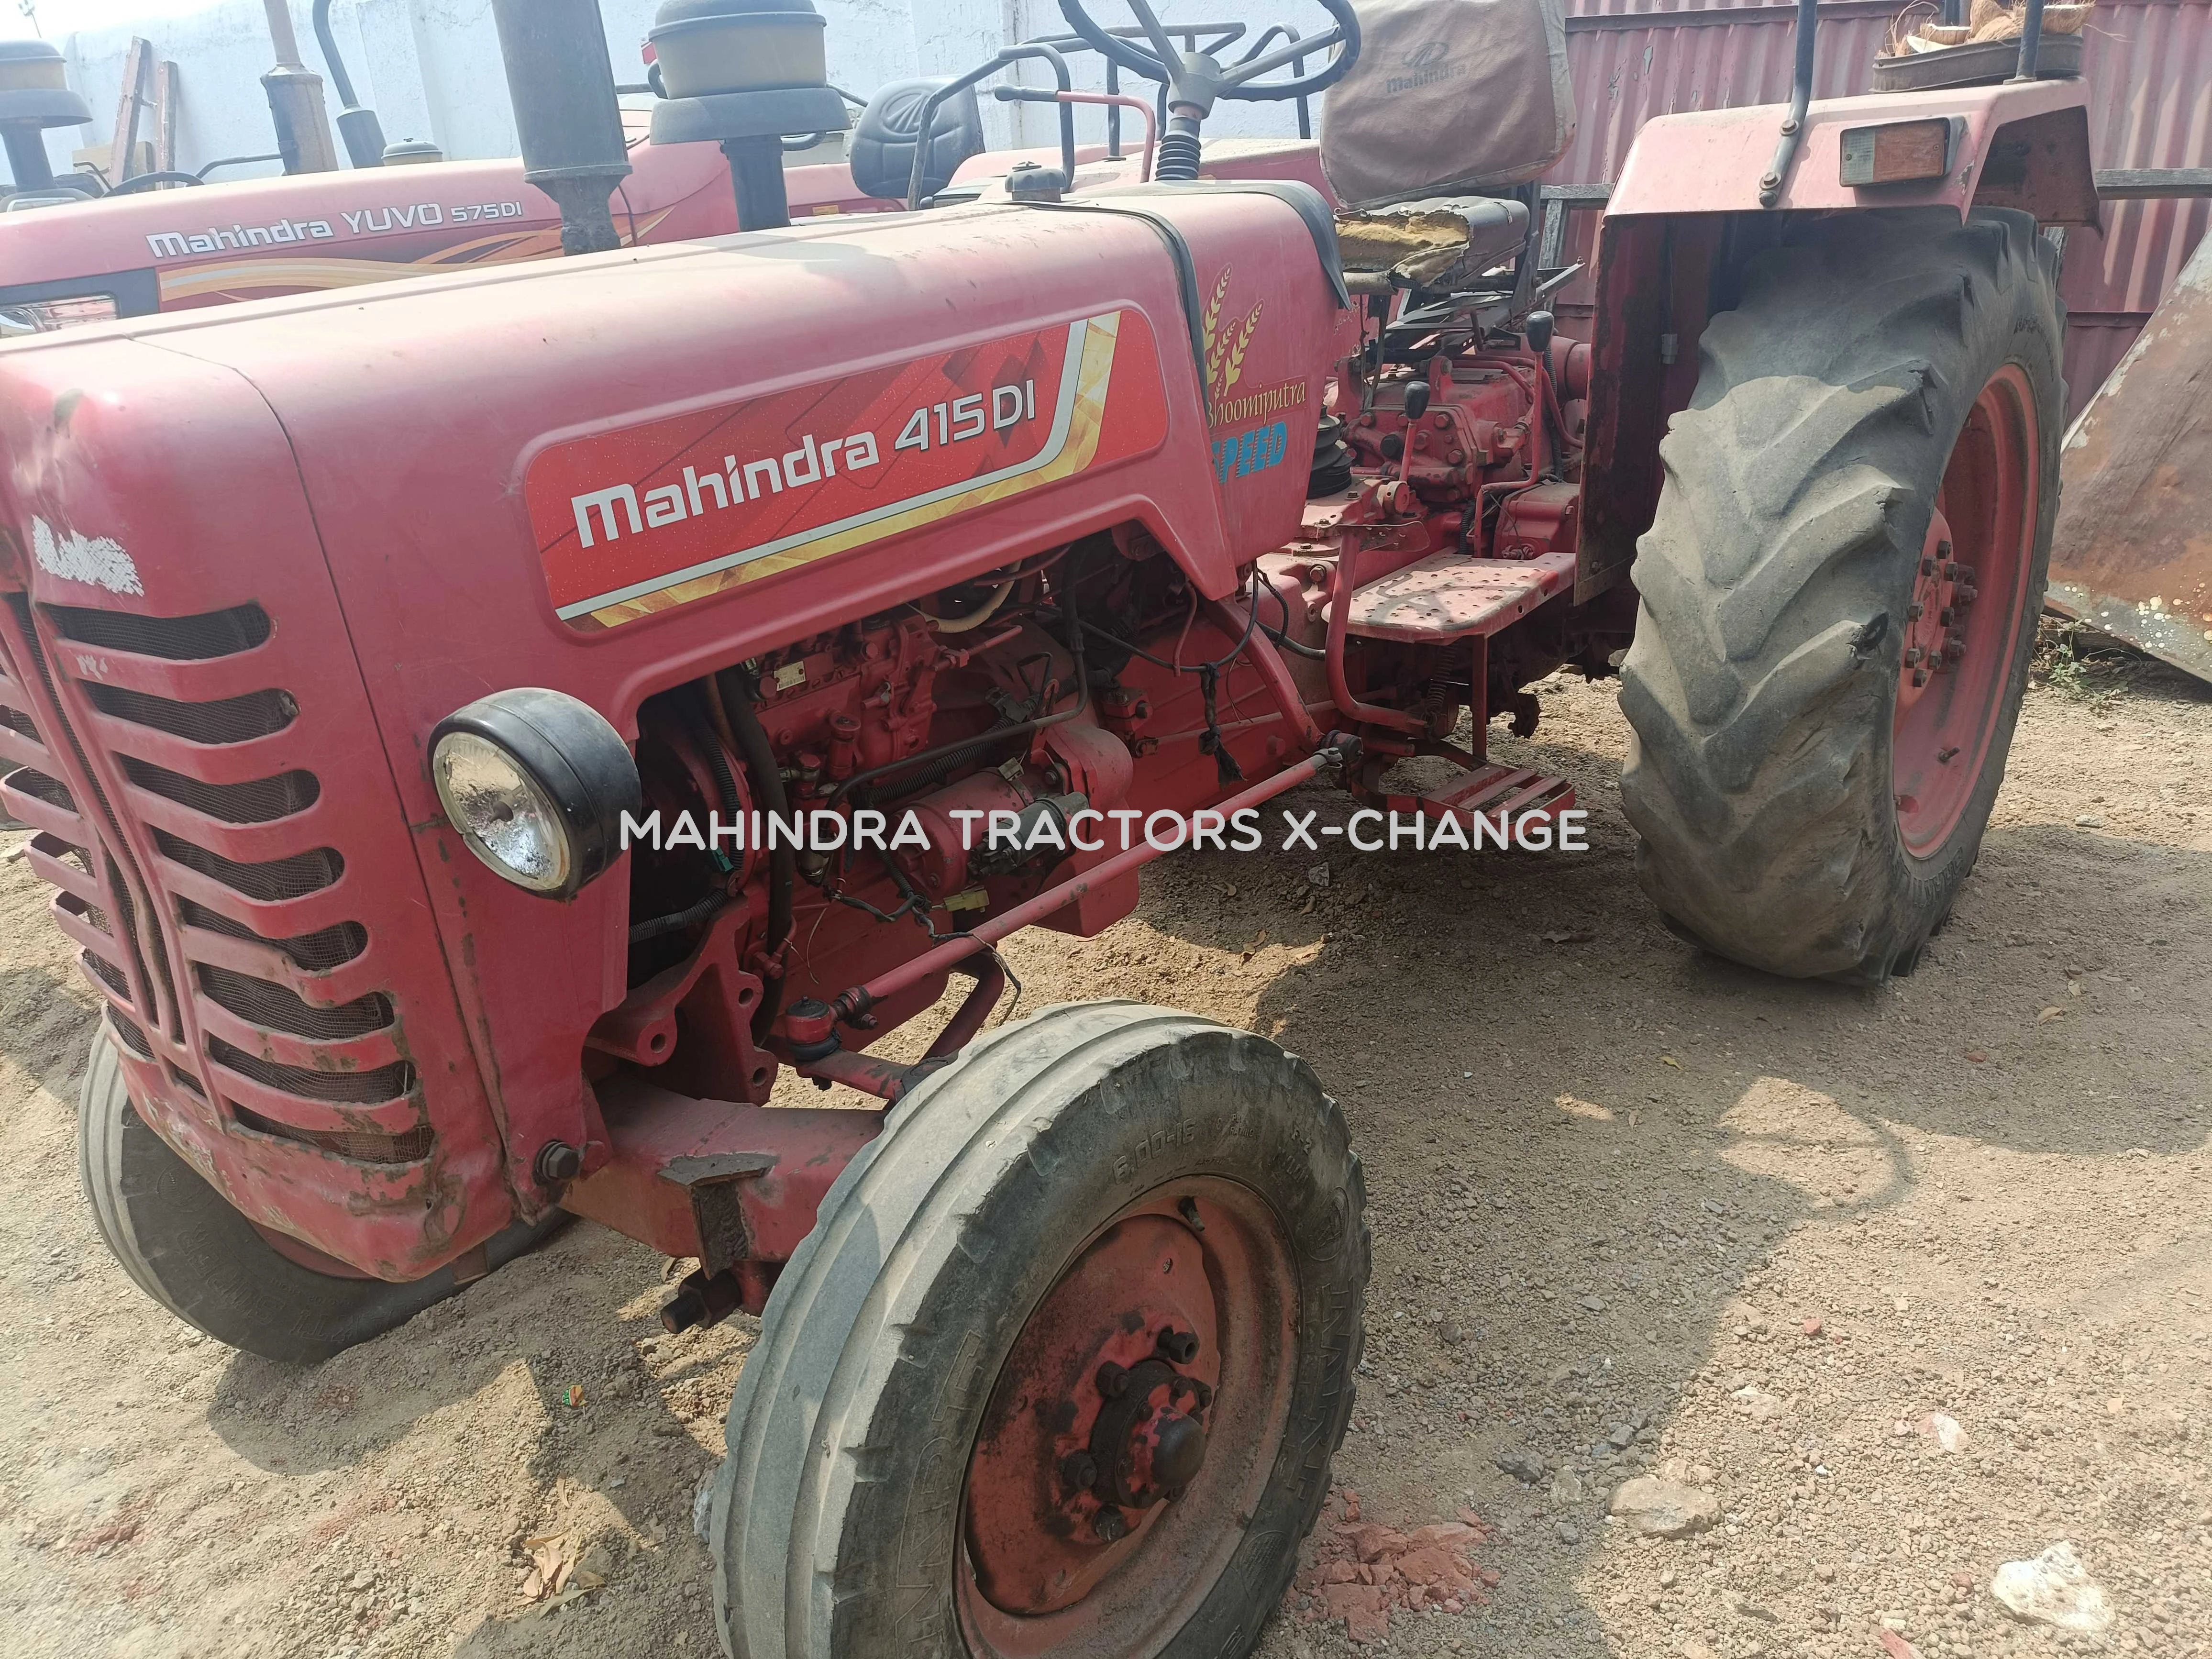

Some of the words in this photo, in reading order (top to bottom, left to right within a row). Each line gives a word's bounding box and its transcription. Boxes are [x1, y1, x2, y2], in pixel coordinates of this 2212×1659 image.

[145, 218, 334, 258] Mahindra
[340, 202, 444, 234] YUVO
[571, 431, 880, 549] Mahindra
[1112, 1116, 1197, 1185] 6.00-16
